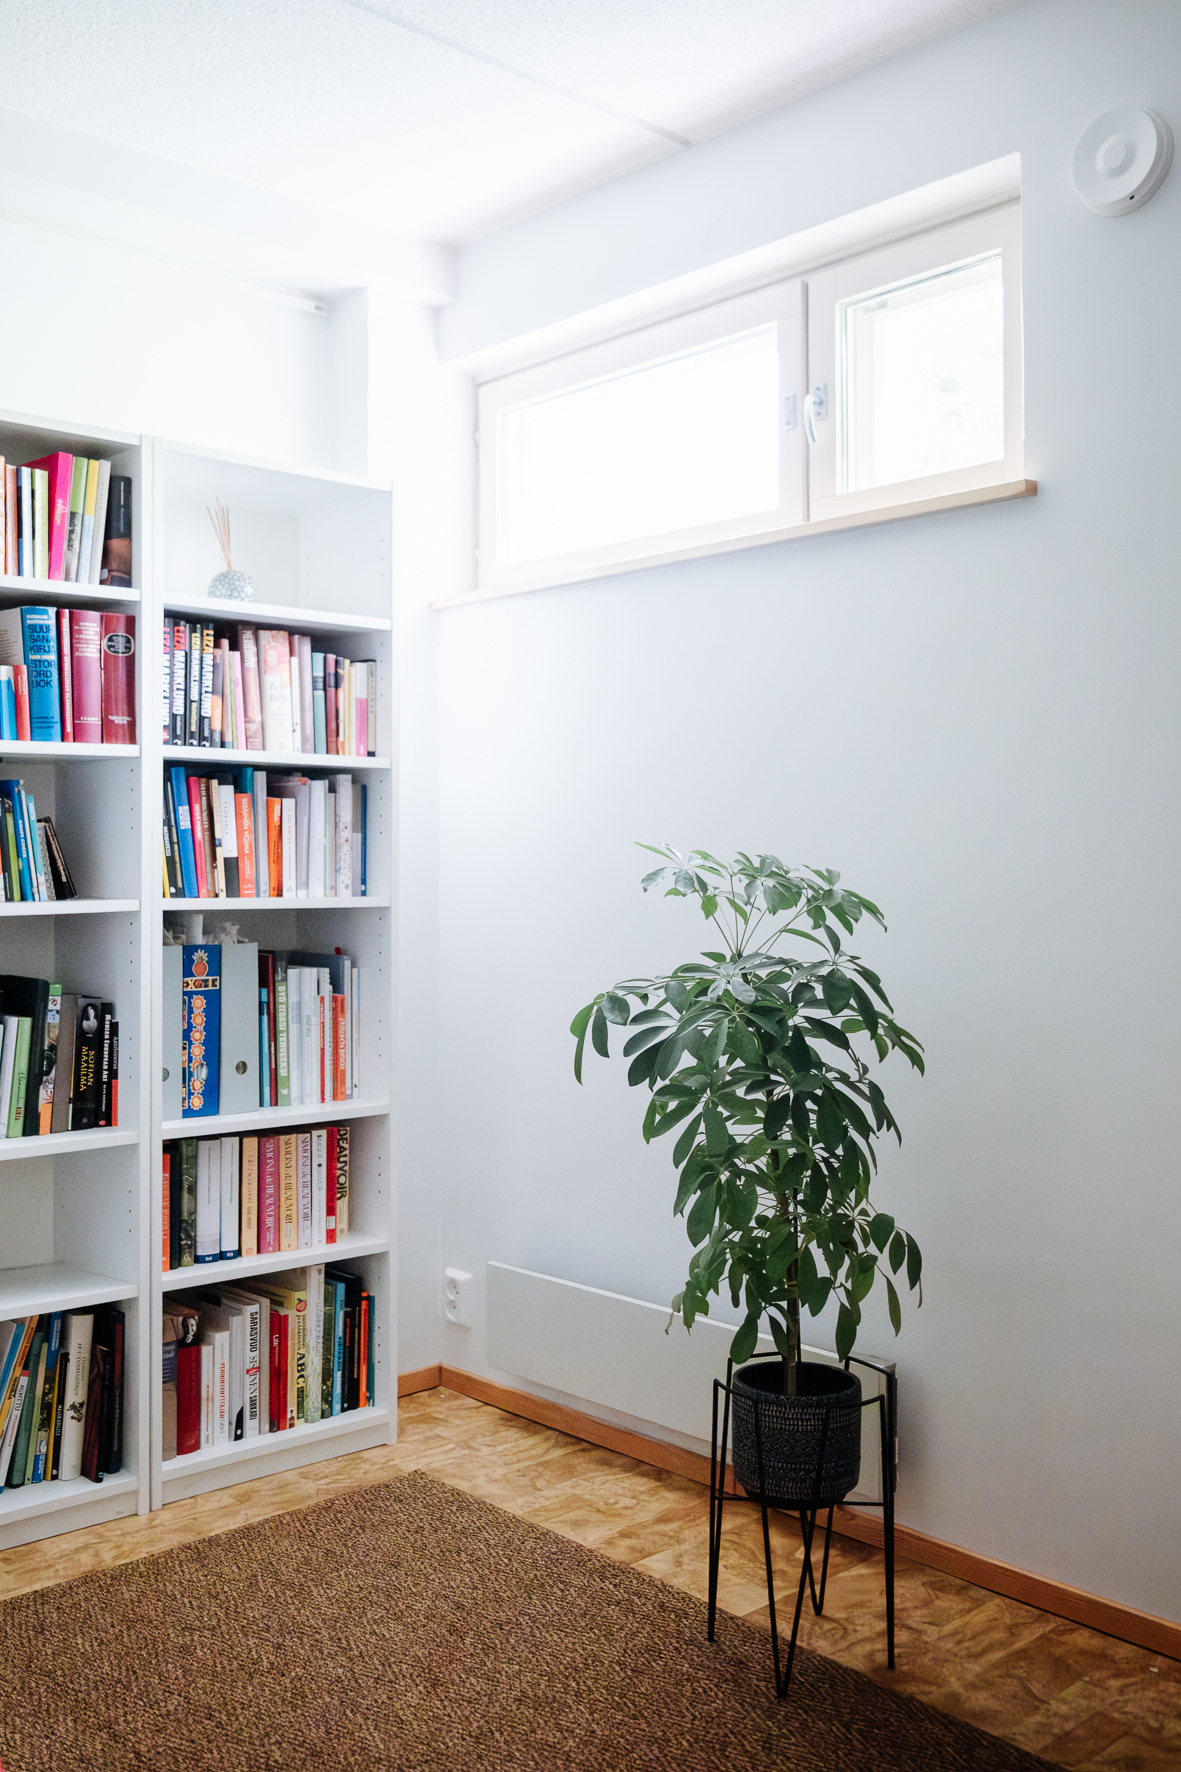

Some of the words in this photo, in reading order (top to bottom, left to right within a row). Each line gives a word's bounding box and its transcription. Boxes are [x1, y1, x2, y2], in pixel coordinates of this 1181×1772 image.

[174, 626, 186, 650] LIZA
[191, 632, 200, 650] LIZA
[203, 629, 214, 654] LIZA
[173, 650, 185, 715] MARKLUND
[190, 650, 200, 701] MARKLUND
[200, 653, 213, 717] MARKLUND
[241, 798, 249, 829] SISÄINEN
[278, 985, 287, 1002] SYÖ
[278, 1004, 287, 1030] ITSESI
[79, 1046, 88, 1091] MAAILMA
[87, 1050, 95, 1085] SOFIAN
[279, 1032, 288, 1076] TERVEEKSI
[265, 1140, 274, 1174] SIMONE
[284, 1138, 292, 1171] SIMONE
[301, 1136, 310, 1169] SIMONE
[266, 1185, 274, 1227] BEAUVOIR
[285, 1182, 293, 1224] BEAUVOIR
[302, 1180, 310, 1222] BEAUVOIR
[249, 1311, 258, 1352] SARASVUO
[296, 1352, 306, 1385] ABC
